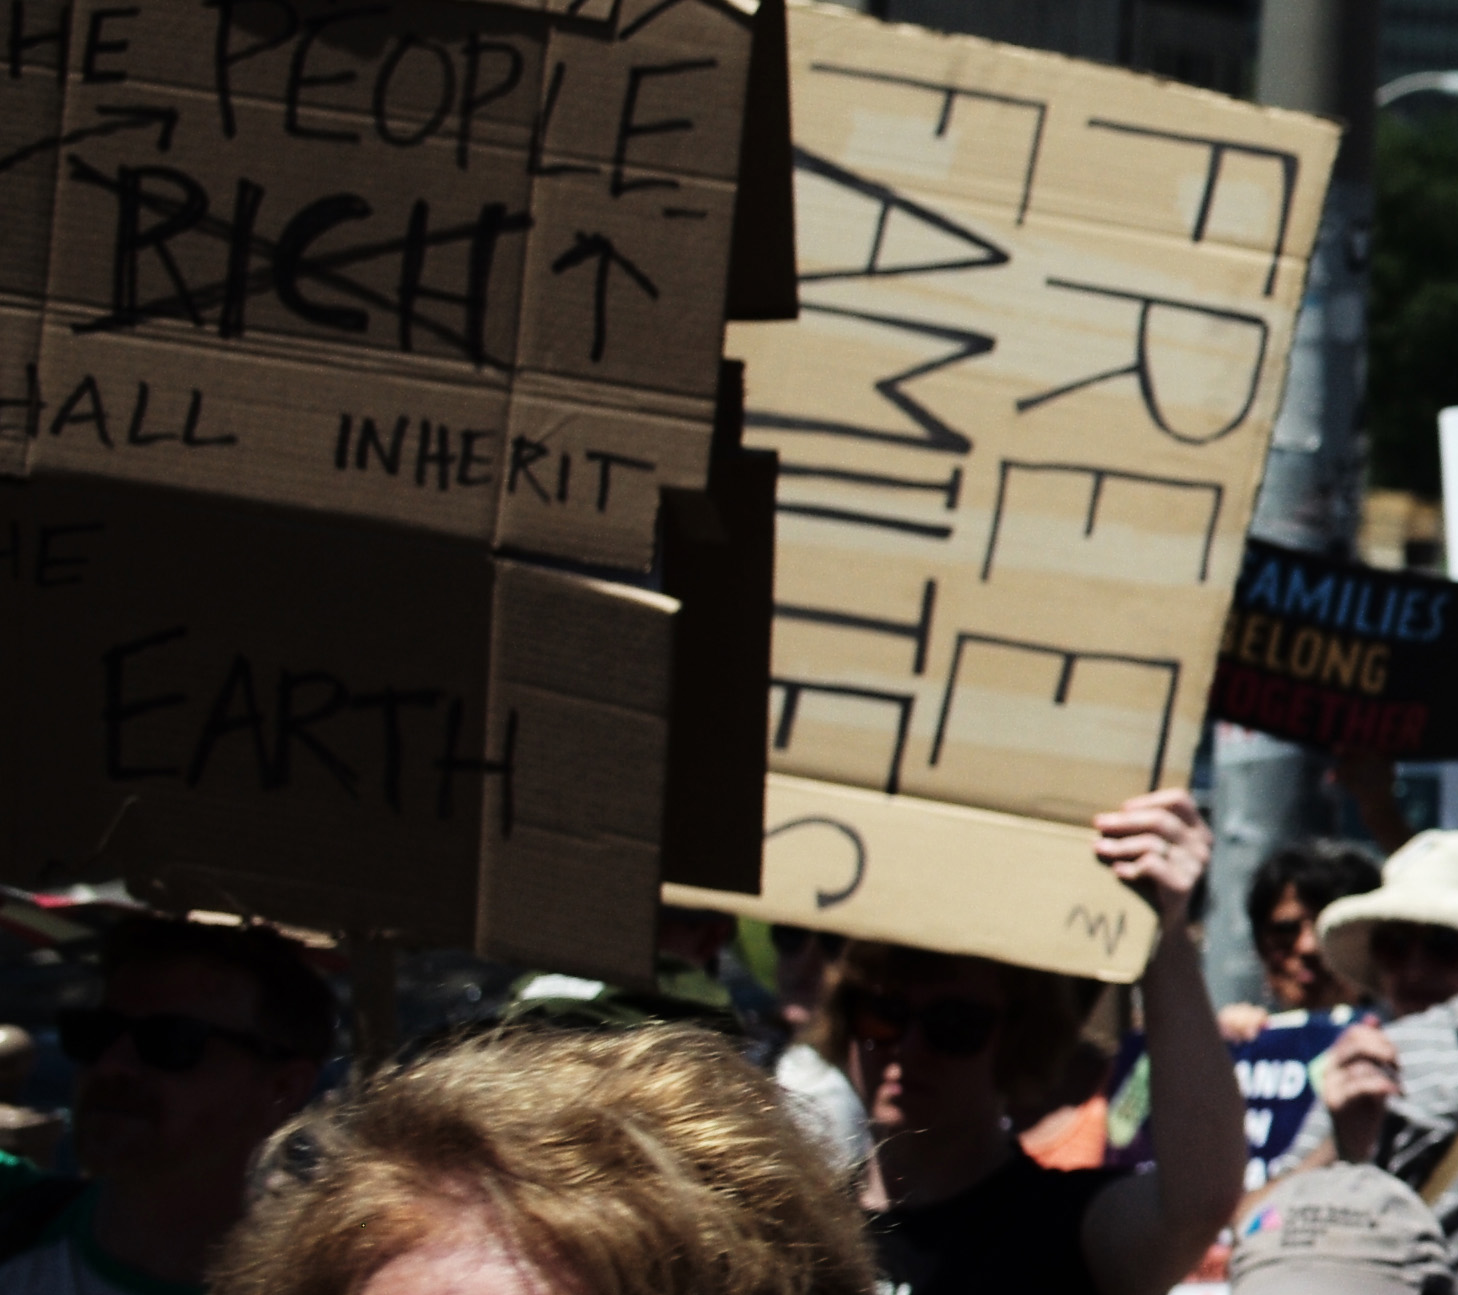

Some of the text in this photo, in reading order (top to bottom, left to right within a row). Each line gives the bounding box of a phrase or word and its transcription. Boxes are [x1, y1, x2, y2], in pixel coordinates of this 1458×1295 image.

[335, 413, 655, 514] INHERIT
[932, 116, 1300, 794] FREE
[103, 628, 518, 835] EARTH
